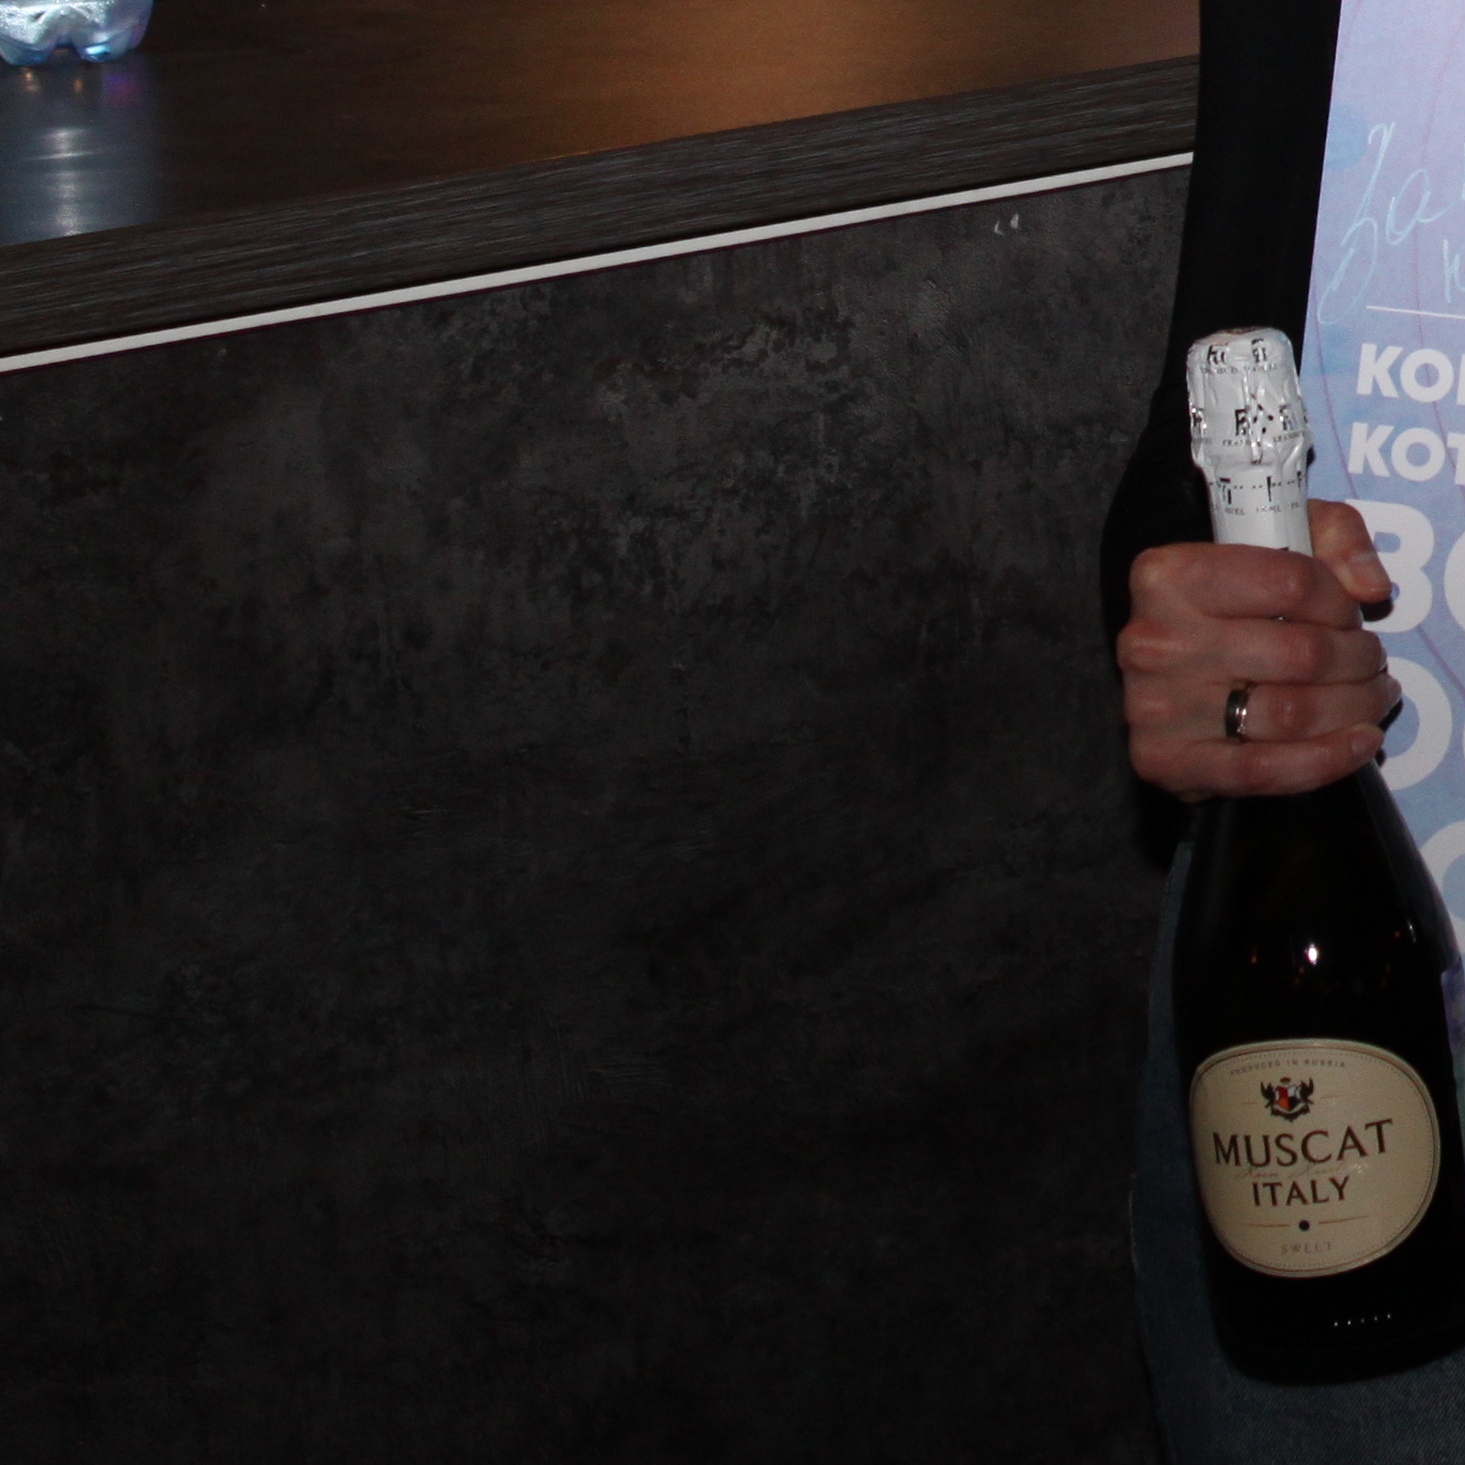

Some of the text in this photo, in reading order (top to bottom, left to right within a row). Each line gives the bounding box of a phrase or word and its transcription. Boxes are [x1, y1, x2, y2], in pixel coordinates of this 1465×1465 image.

[1286, 1059, 1299, 1067] IN
[1304, 1058, 1347, 1069] RUSSIA
[1212, 1118, 1394, 1168] MUSCAT
[1251, 1175, 1351, 1207] ITALY
[1281, 1242, 1332, 1255] SWEET
